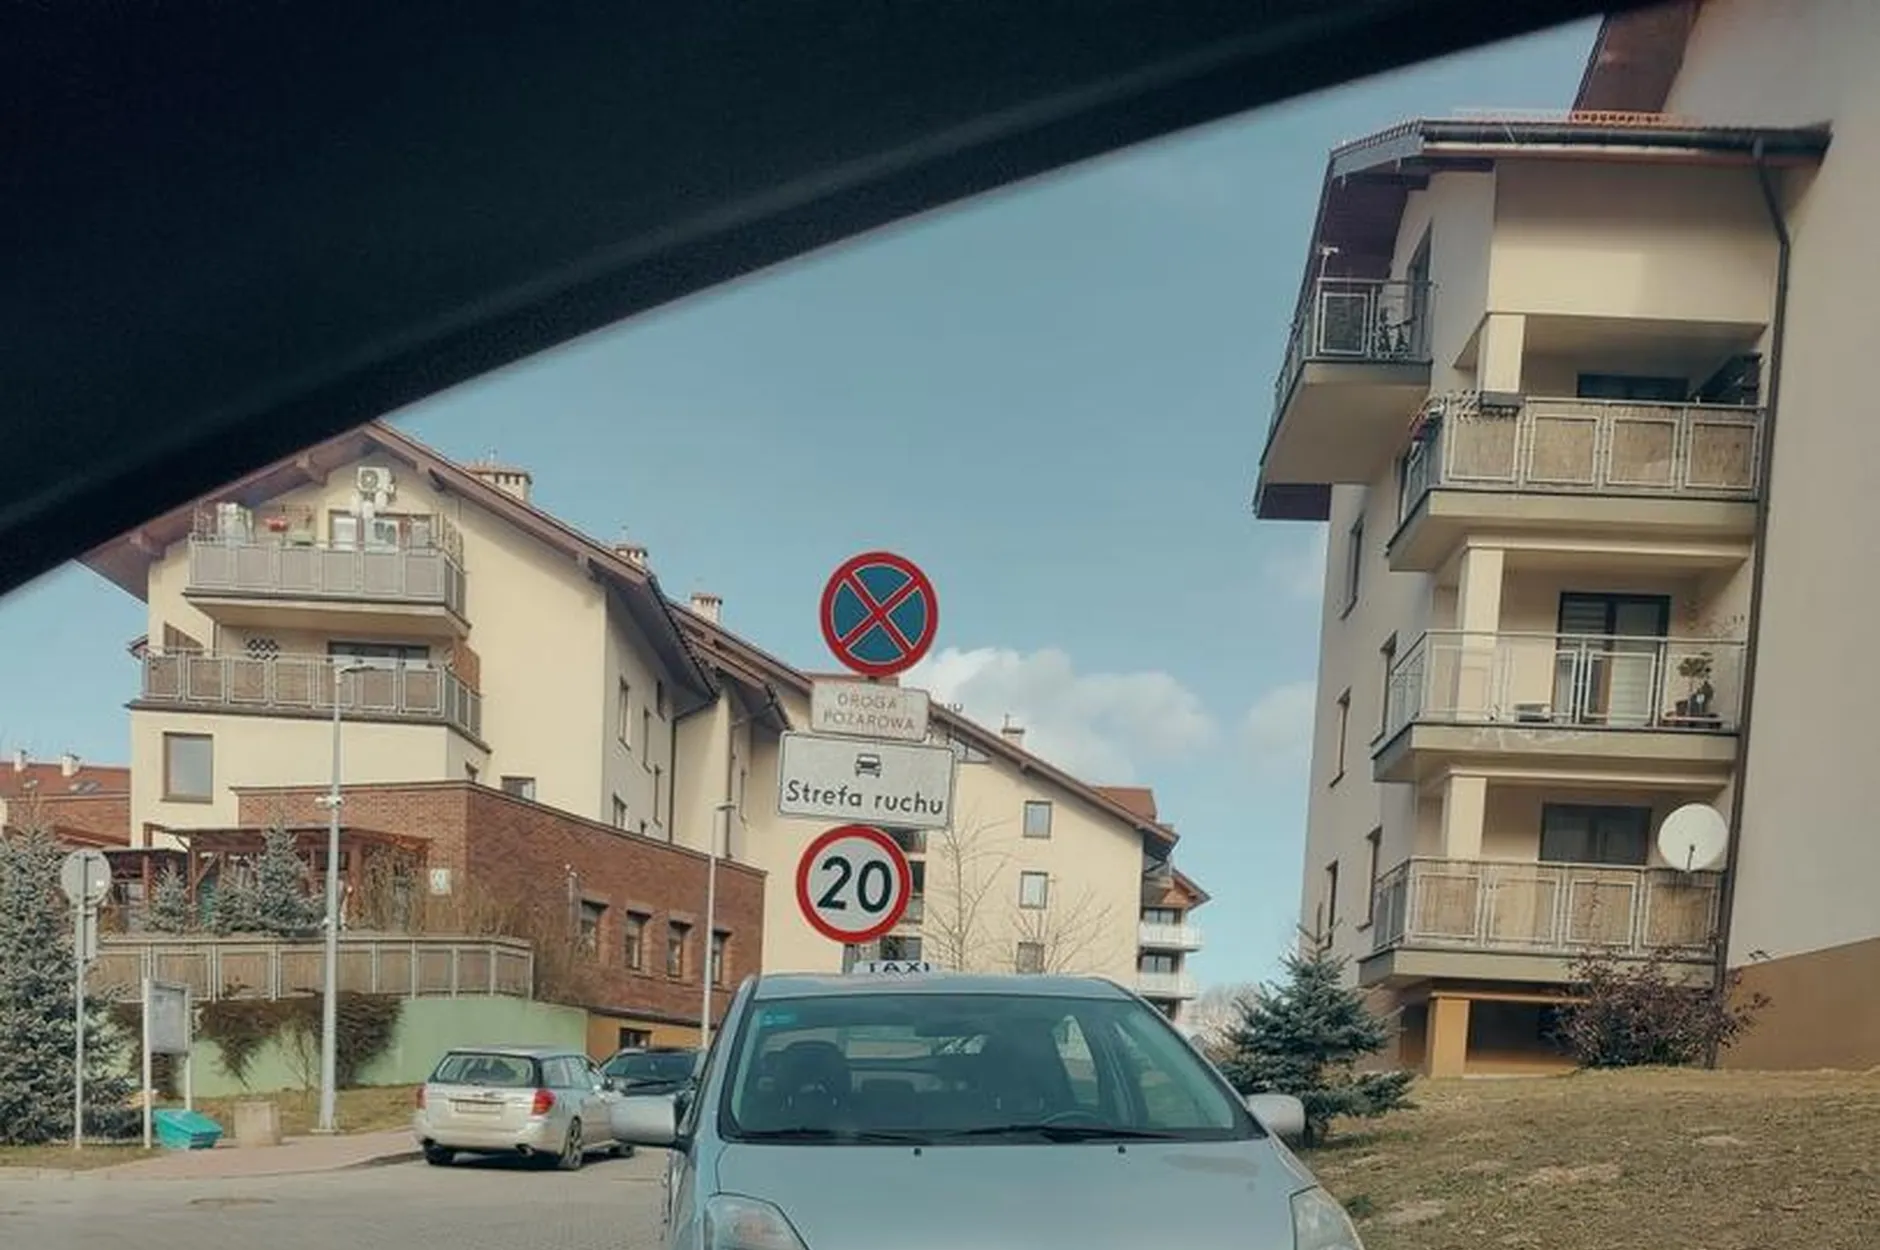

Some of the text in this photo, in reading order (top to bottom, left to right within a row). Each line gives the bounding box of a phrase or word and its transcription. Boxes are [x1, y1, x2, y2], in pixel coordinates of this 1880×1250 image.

[837, 693, 898, 710] DROGA
[786, 779, 943, 815] Strefa ruchu
[817, 855, 892, 913] 20
[869, 962, 930, 973] TAXI
